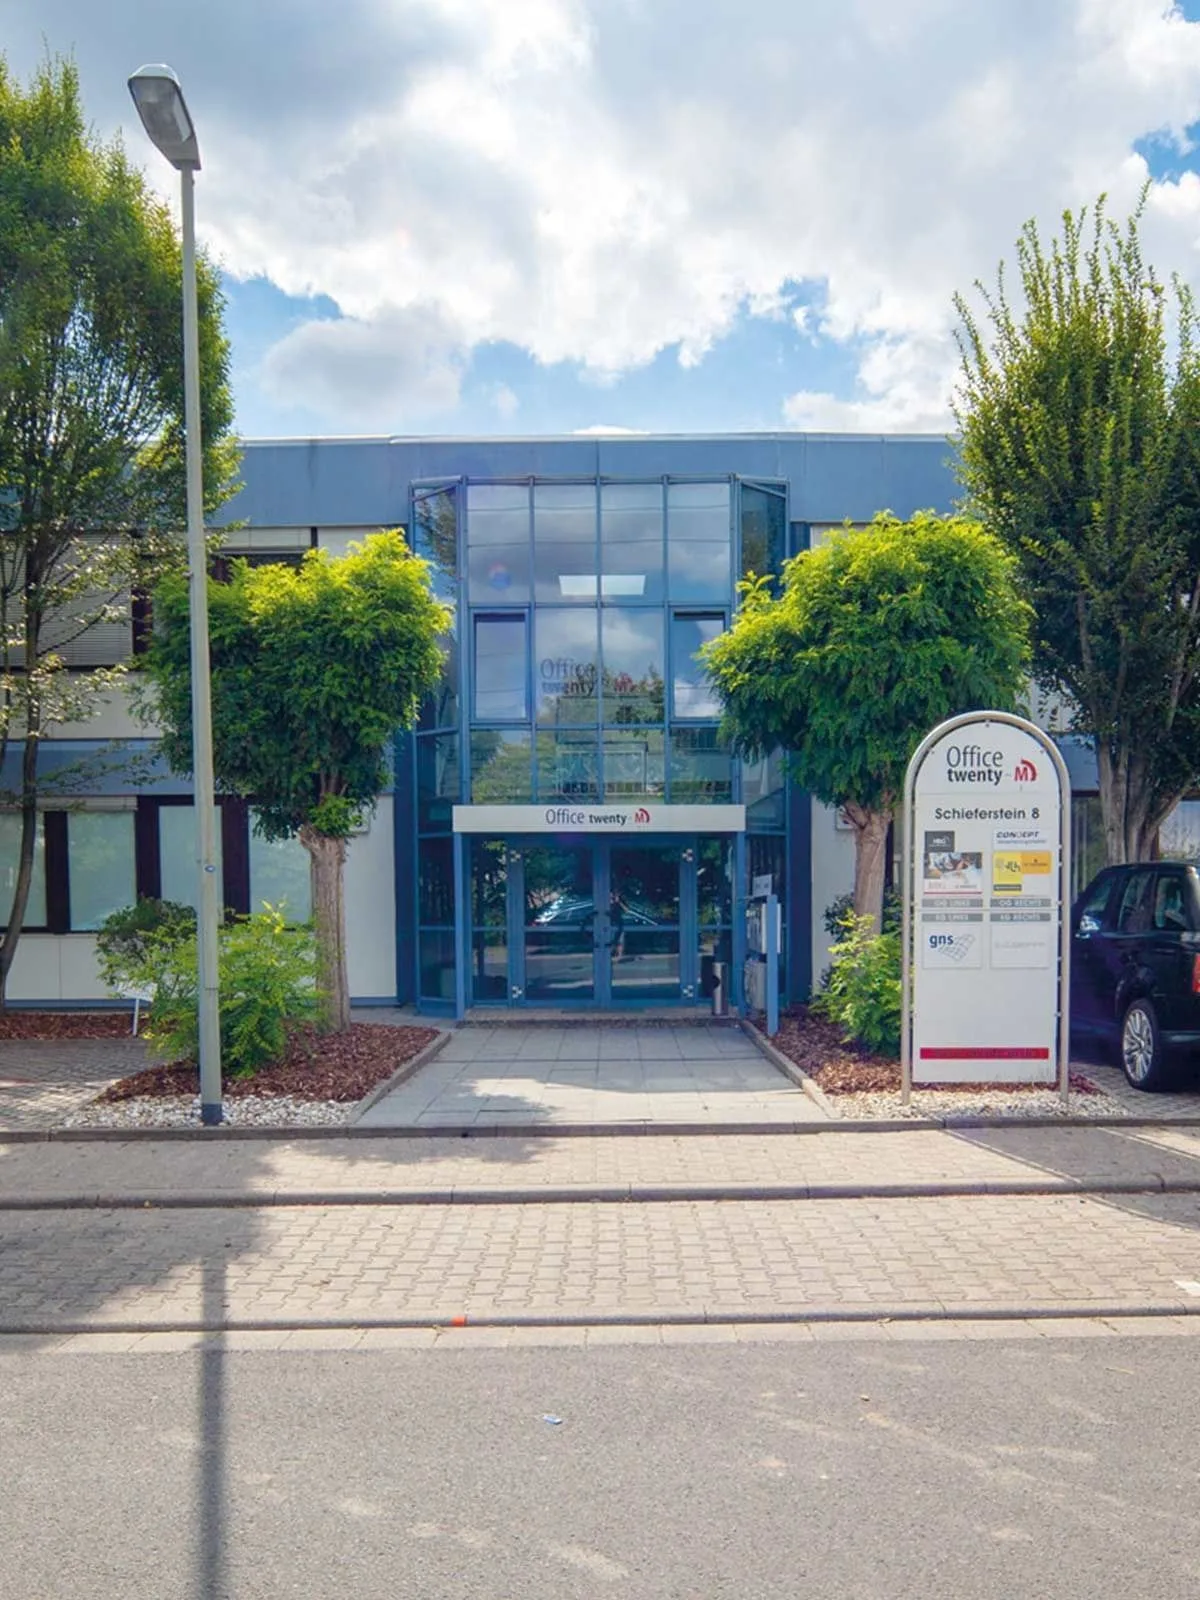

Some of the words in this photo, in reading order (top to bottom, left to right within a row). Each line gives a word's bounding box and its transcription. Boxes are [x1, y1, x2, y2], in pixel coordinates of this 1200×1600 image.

[540, 658, 596, 680] Office
[542, 681, 596, 696] nty
[947, 746, 1003, 767] Office
[947, 769, 1002, 785] twenty
[545, 808, 585, 825] Office
[588, 814, 627, 826] twenty
[935, 807, 1026, 820] Schieferstein
[1031, 808, 1040, 819] 8
[929, 934, 954, 949] gns
